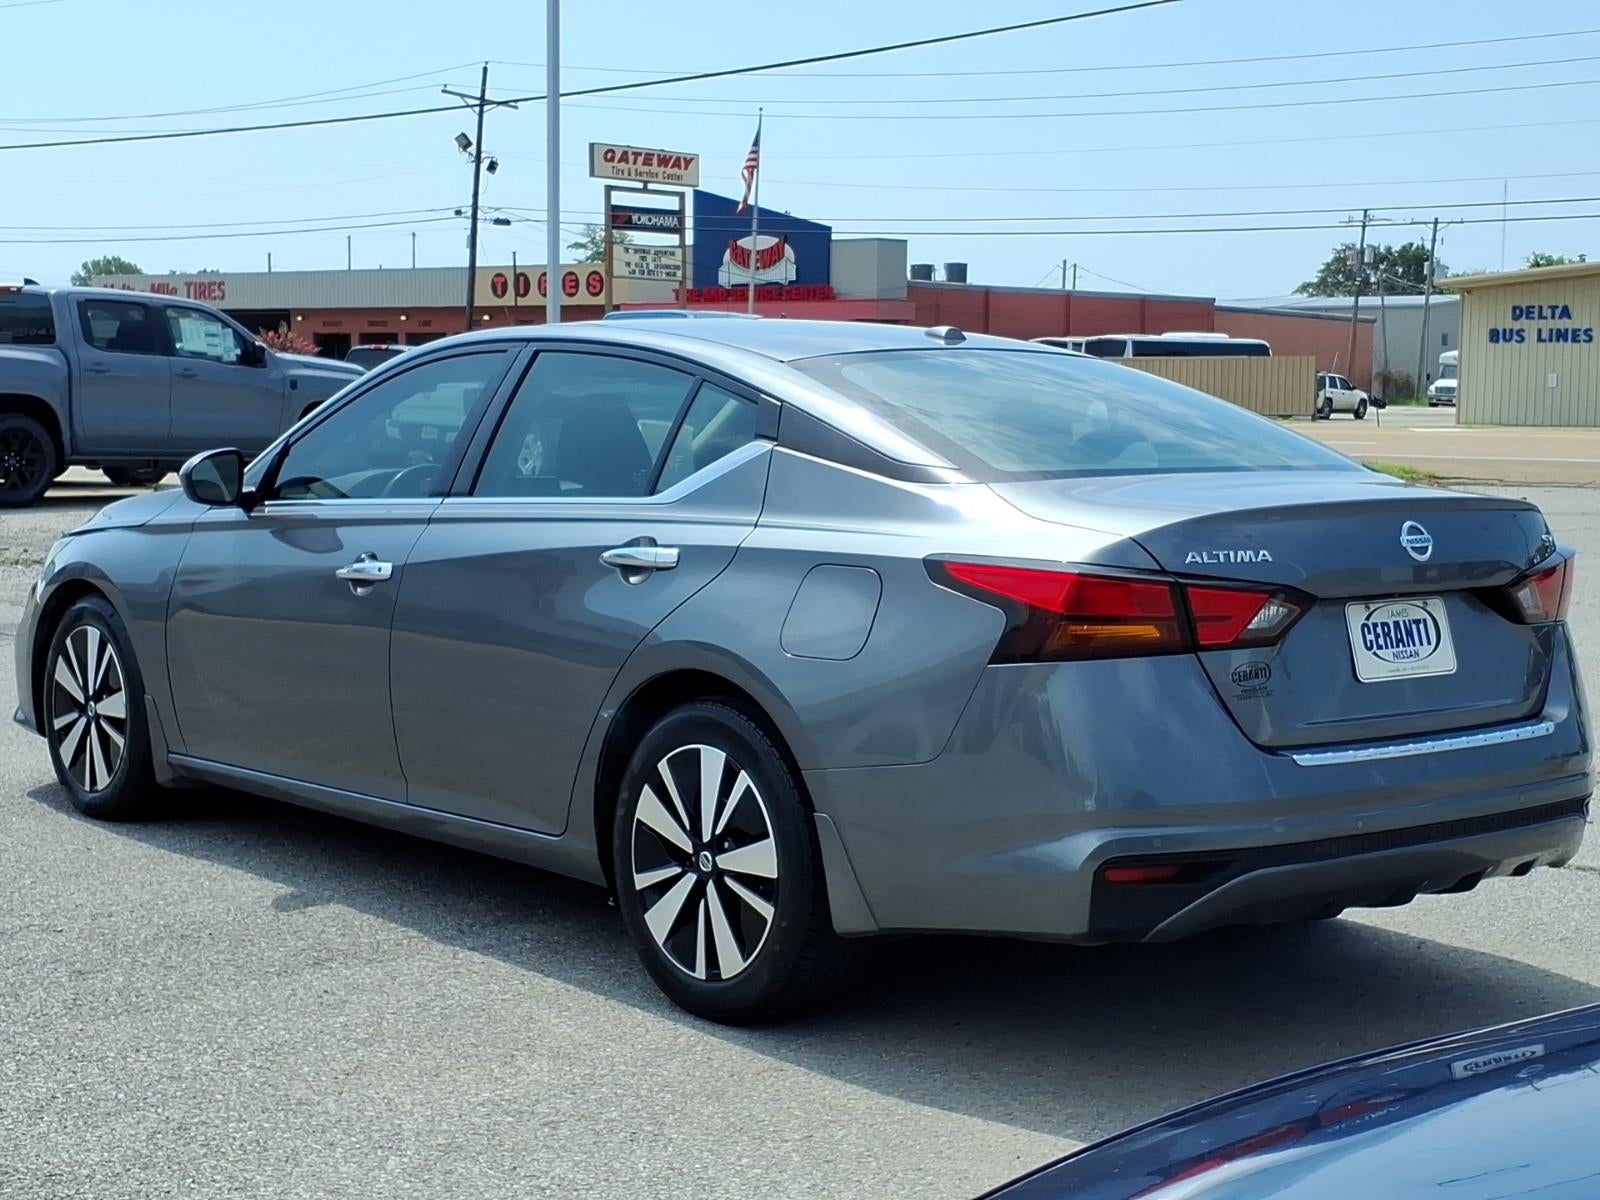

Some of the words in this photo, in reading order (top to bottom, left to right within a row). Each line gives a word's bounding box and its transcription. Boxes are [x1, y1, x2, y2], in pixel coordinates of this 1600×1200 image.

[603, 148, 695, 170] GATEWAY
[611, 166, 624, 176] Tire
[634, 167, 659, 180] Service
[662, 171, 684, 182] Center
[631, 214, 679, 228] YOKOHAMA
[184, 281, 225, 300] TIRES
[672, 289, 702, 302] TRE
[1511, 305, 1572, 321] DELTA
[1489, 328, 1526, 343] BUS
[1537, 328, 1593, 343] LINES
[1185, 550, 1273, 564] ALTIMA
[1360, 618, 1432, 652] CERANTI
[1392, 650, 1420, 661] NISSAN
[1231, 667, 1267, 683] CERANTI
